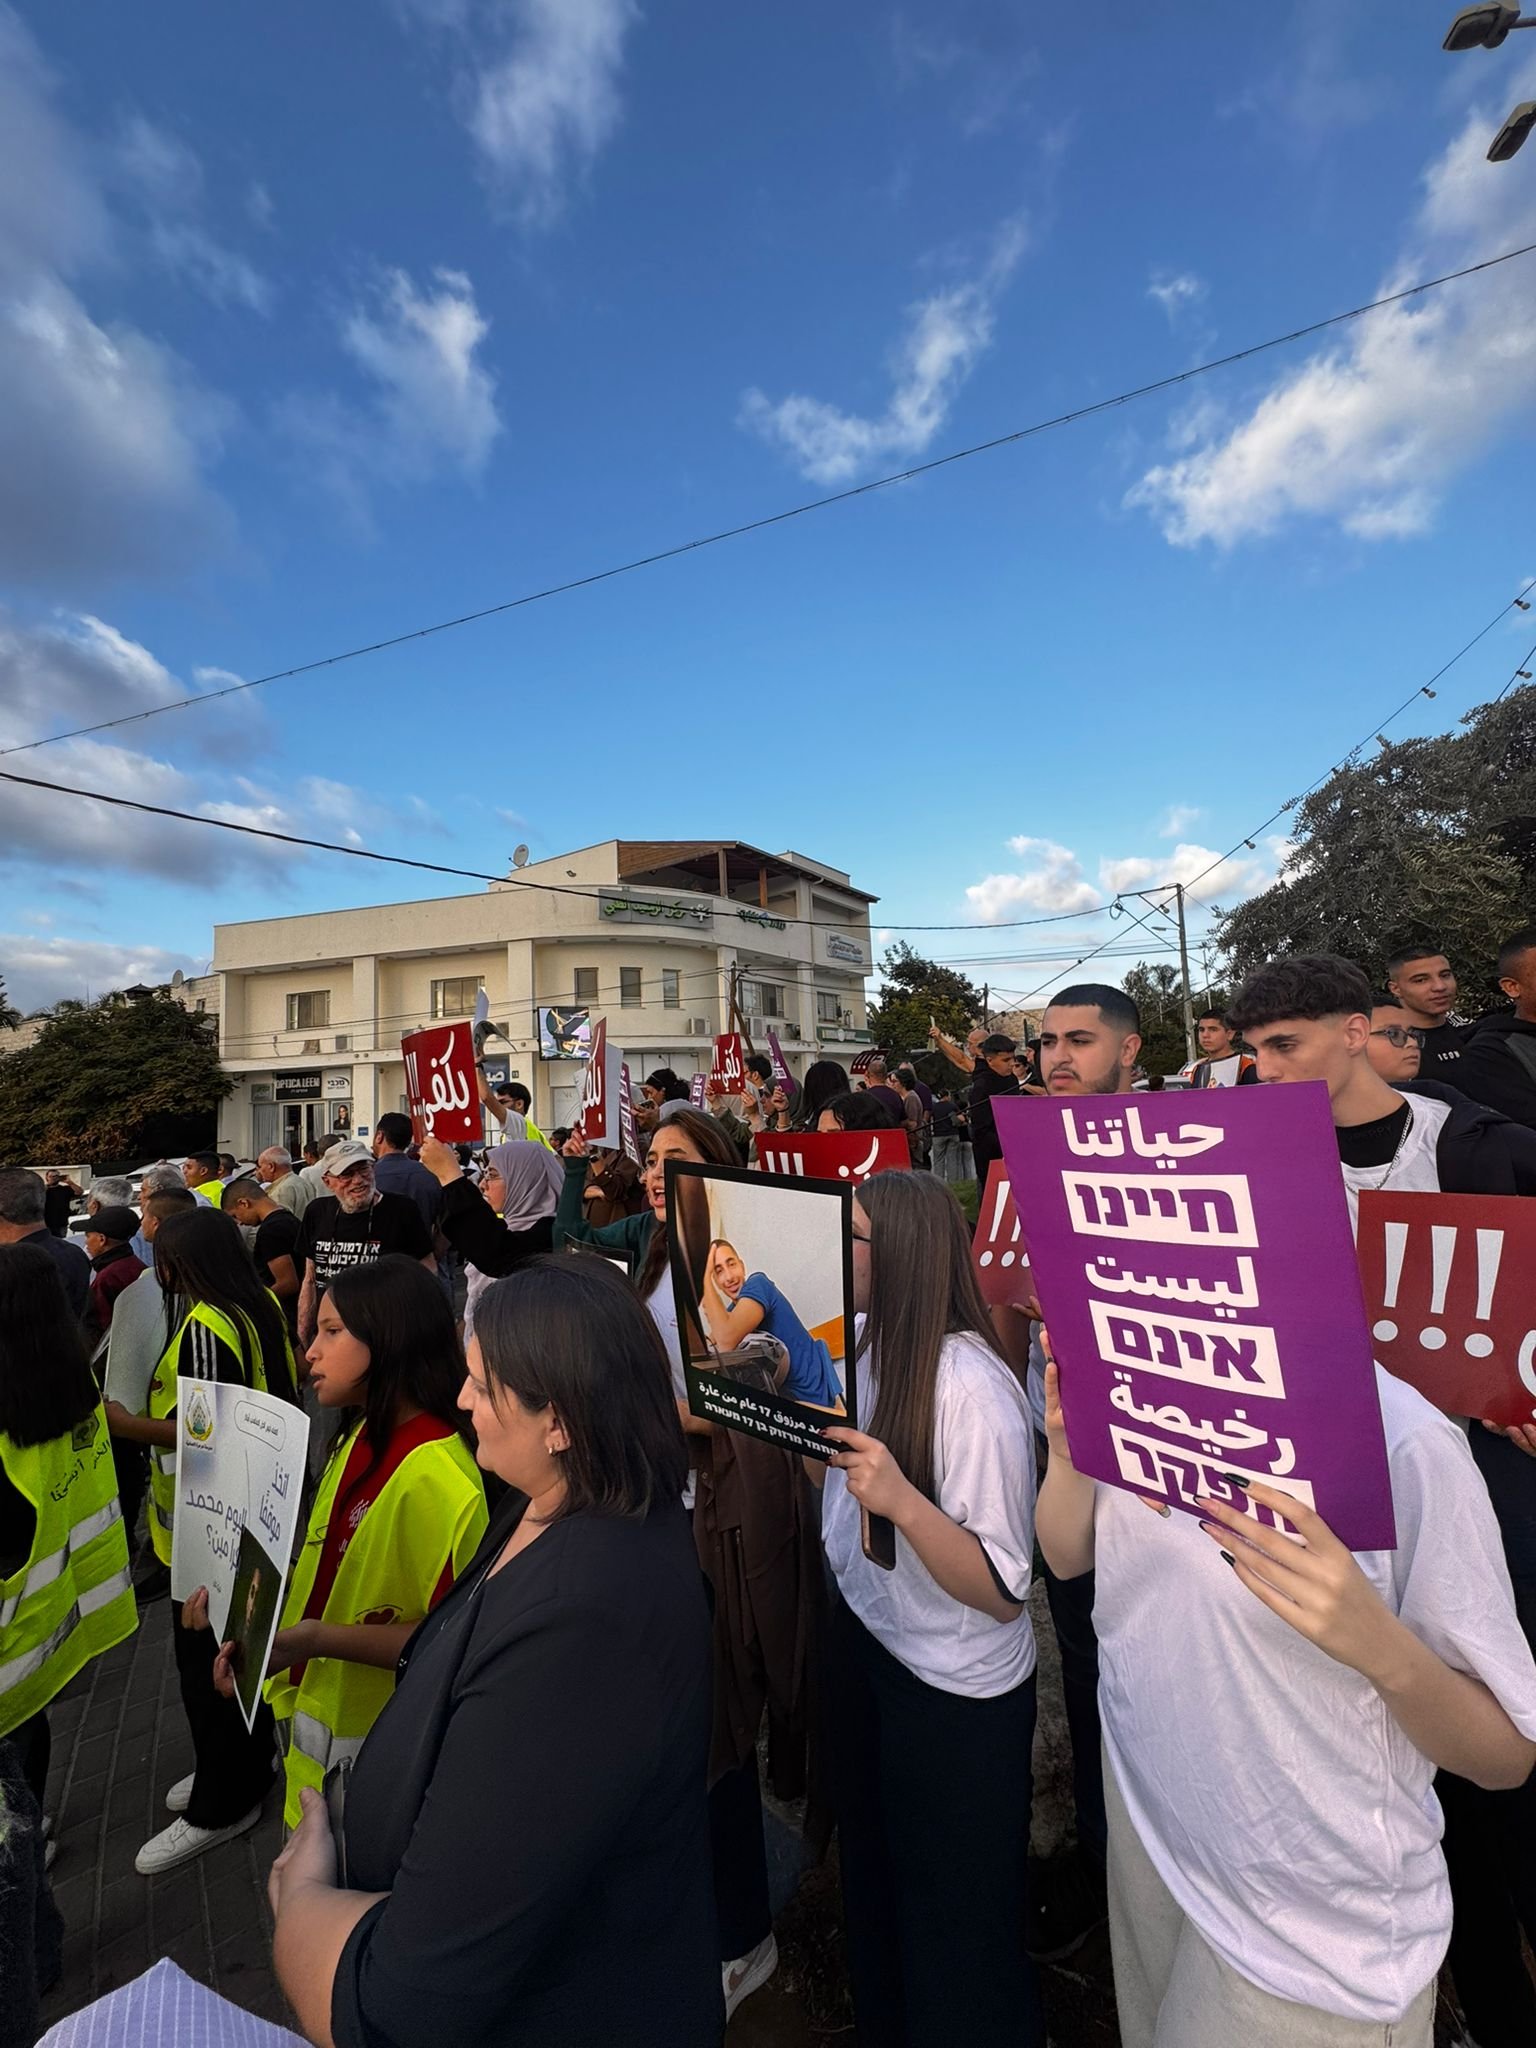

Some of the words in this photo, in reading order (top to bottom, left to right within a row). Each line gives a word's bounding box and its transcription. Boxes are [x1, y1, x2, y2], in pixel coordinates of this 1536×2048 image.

[1061, 1107, 1224, 1169] حياتنا
[1074, 1183, 1239, 1234] חיינו
[1085, 1256, 1259, 1318] ليست
[1106, 1316, 1266, 1384] אינם
[722, 1392, 737, 1404] من
[740, 1398, 758, 1411] عام
[1110, 1370, 1296, 1475] رخيصة
[185, 1490, 224, 1515] محمد
